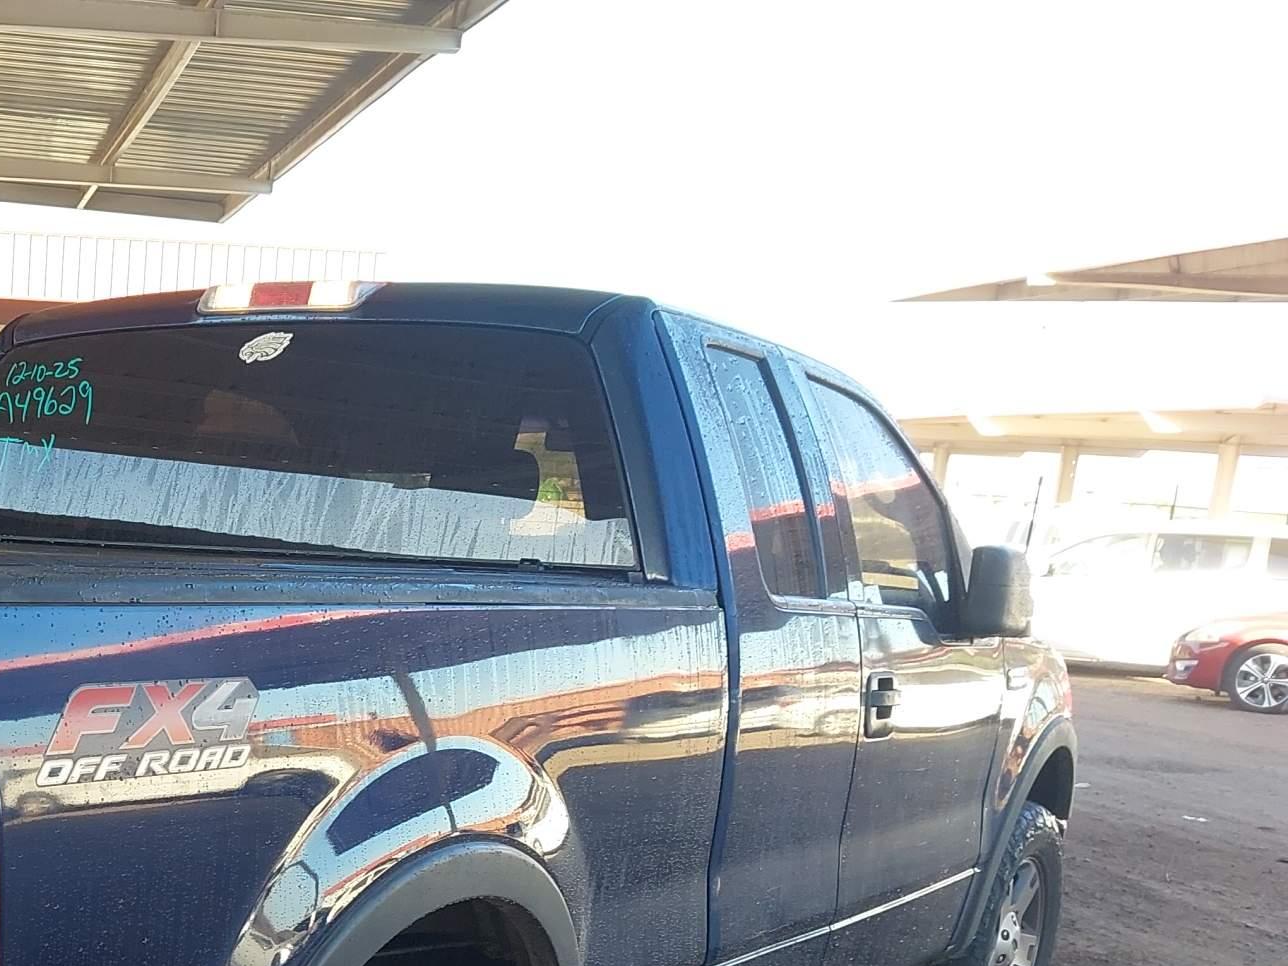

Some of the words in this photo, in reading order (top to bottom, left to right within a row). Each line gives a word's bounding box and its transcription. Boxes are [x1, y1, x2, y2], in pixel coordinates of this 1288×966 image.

[5, 357, 84, 387] 12-10-25
[45, 679, 259, 756] FX4
[36, 753, 128, 787] OFF
[135, 743, 252, 777] ROAD
